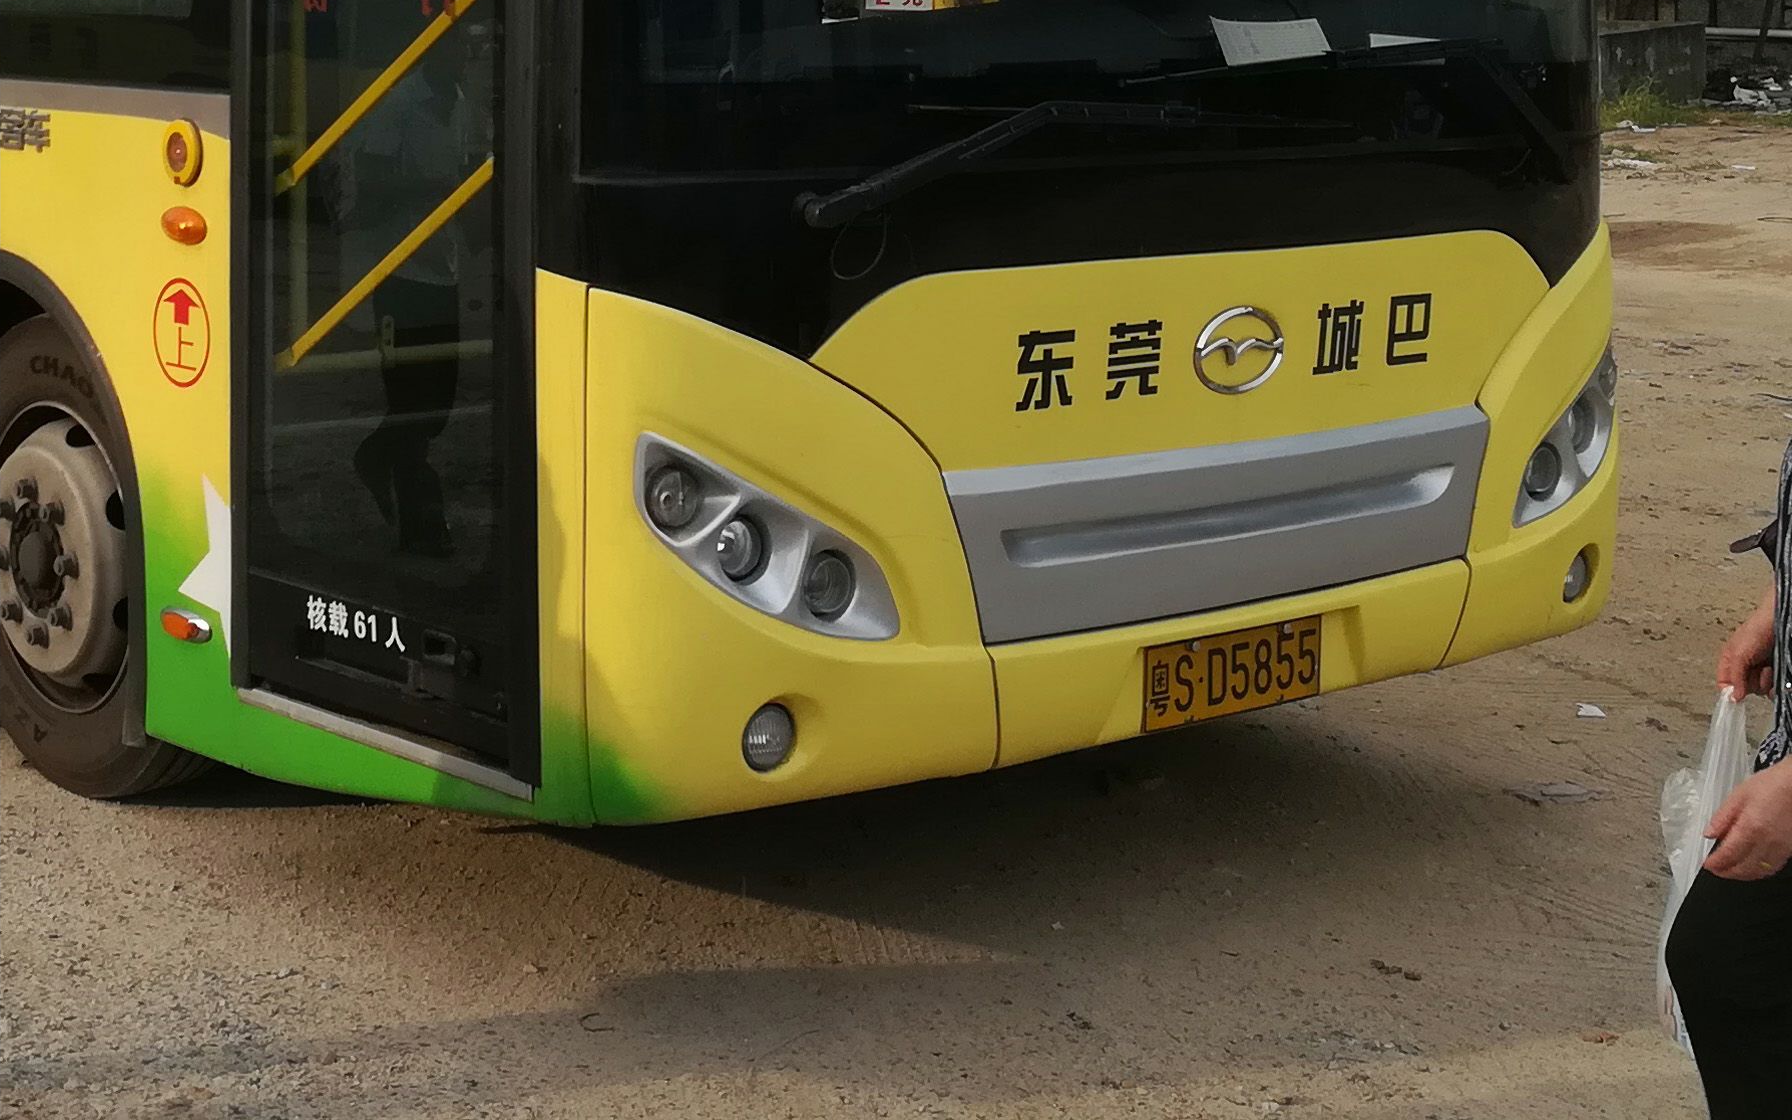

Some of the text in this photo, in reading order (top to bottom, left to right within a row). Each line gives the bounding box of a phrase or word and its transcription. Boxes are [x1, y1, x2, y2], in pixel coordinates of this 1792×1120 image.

[165, 326, 197, 372] 上
[1015, 293, 1432, 412] 东莞 城巴
[306, 594, 406, 652] 核载 61 人
